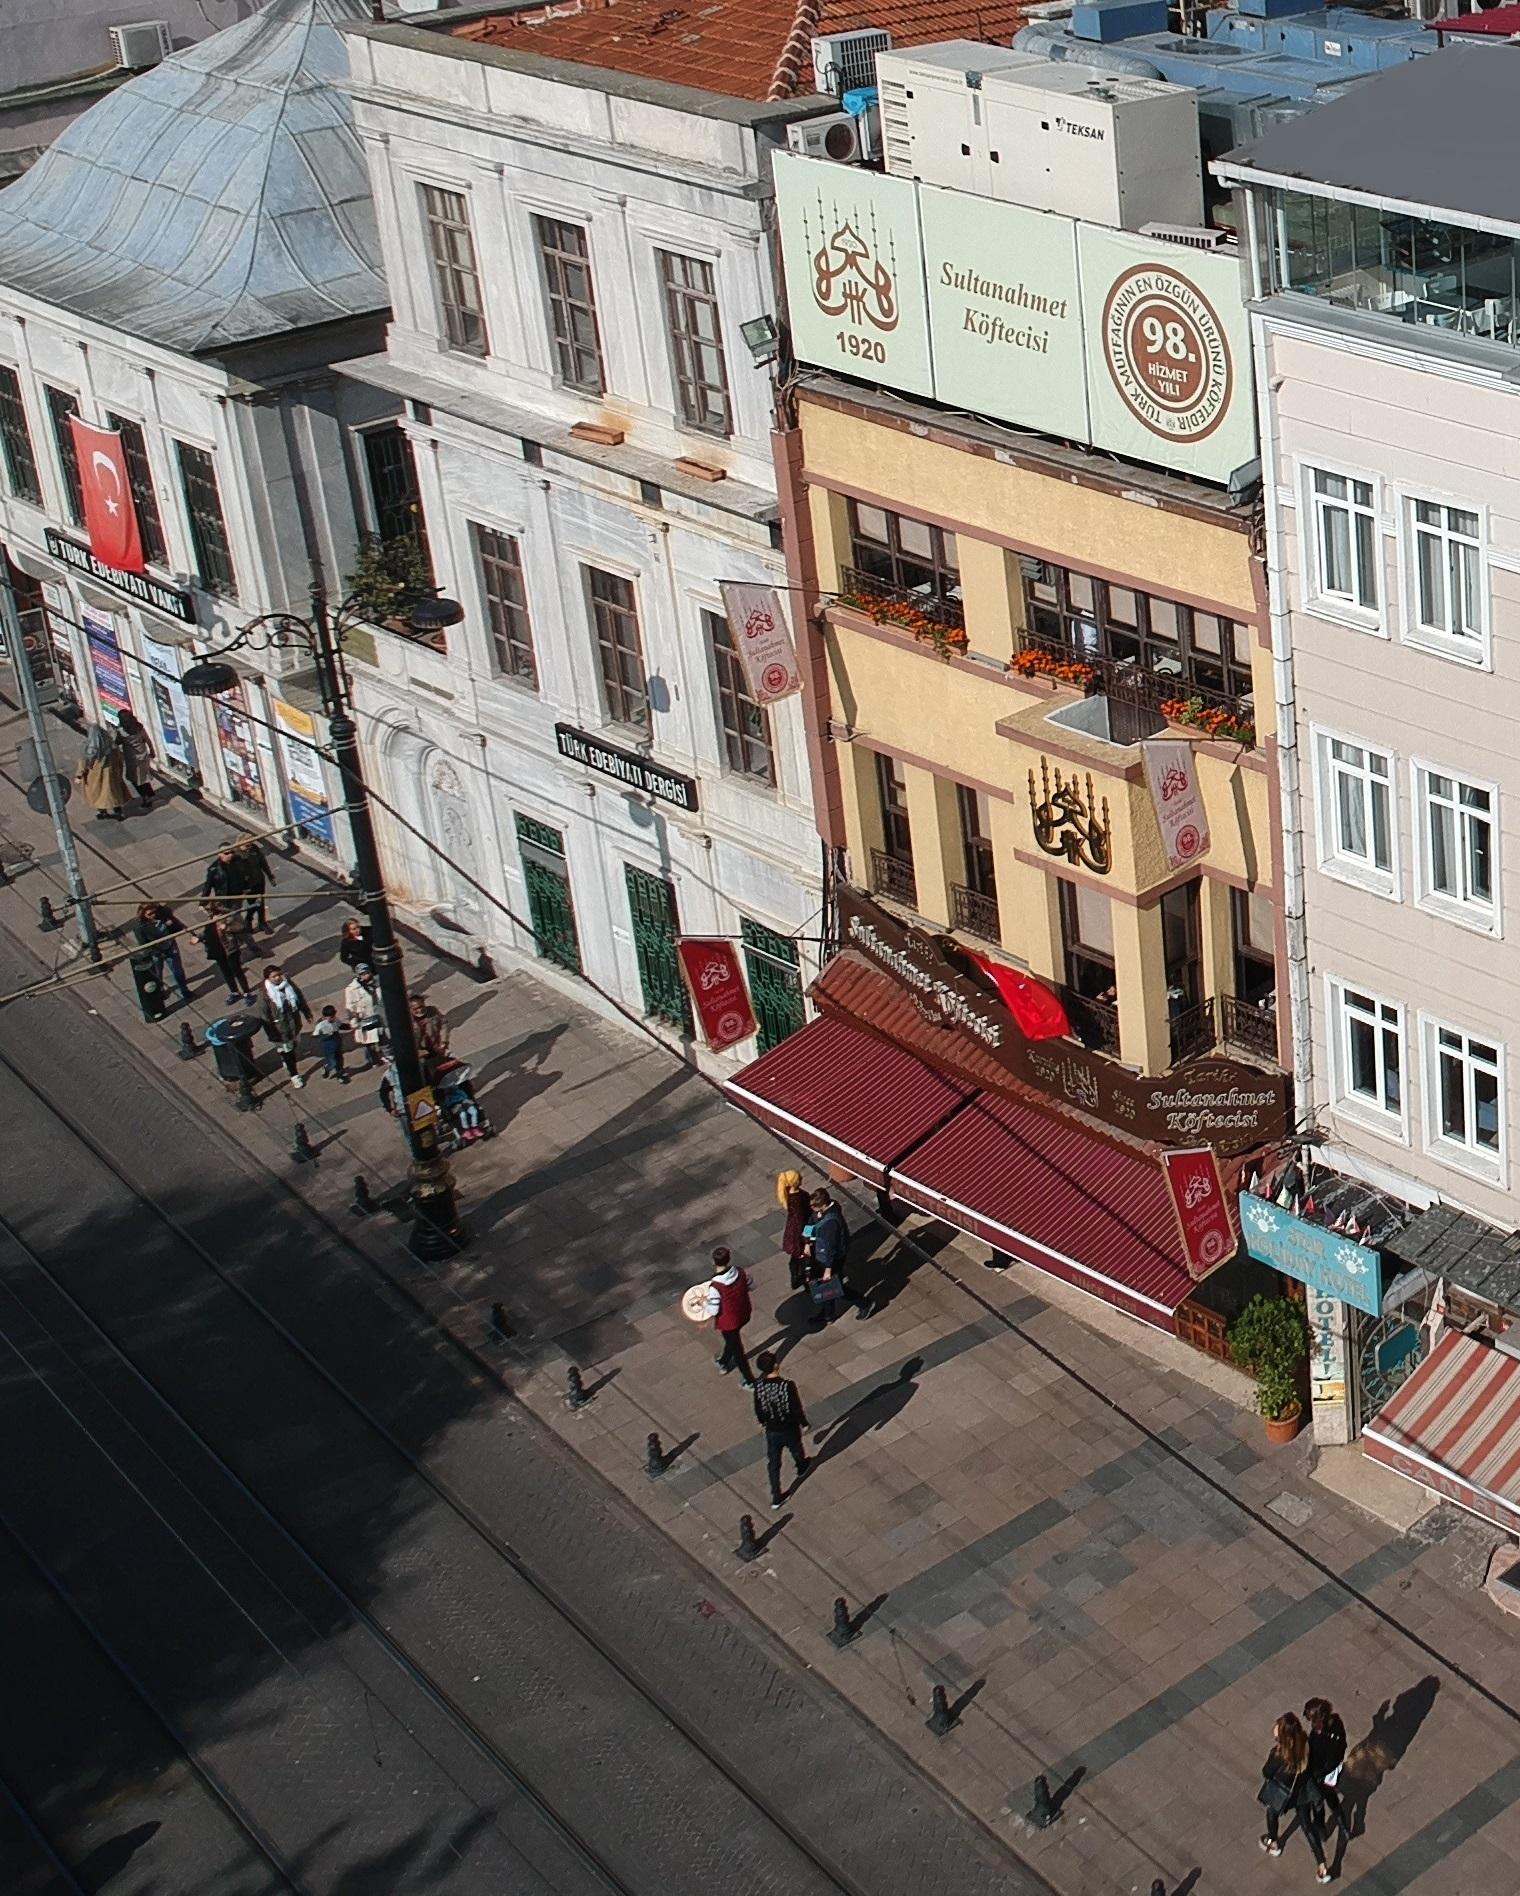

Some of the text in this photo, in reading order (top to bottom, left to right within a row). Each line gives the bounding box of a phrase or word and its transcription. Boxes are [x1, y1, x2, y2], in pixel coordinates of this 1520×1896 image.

[1066, 122, 1105, 141] TEKSAN
[940, 261, 1067, 319] Sultanahmet
[1136, 277, 1153, 293] EN
[1155, 275, 1200, 315] ÖZGÜN
[836, 331, 886, 364] 1920
[963, 307, 1049, 354] Köftecisi
[1142, 316, 1197, 363] 98.
[1199, 313, 1225, 376] ÜRÜNÜ
[1148, 362, 1188, 383] HİZMET
[1158, 379, 1180, 397] YILI
[1130, 386, 1162, 425] TÜRK
[559, 732, 688, 807] TÜRK EDEBİYATI DERGİSİ
[1146, 1086, 1276, 1110] Sultanahmet
[1166, 1109, 1259, 1134] Köftecisi
[1392, 1454, 1461, 1499] CAN
